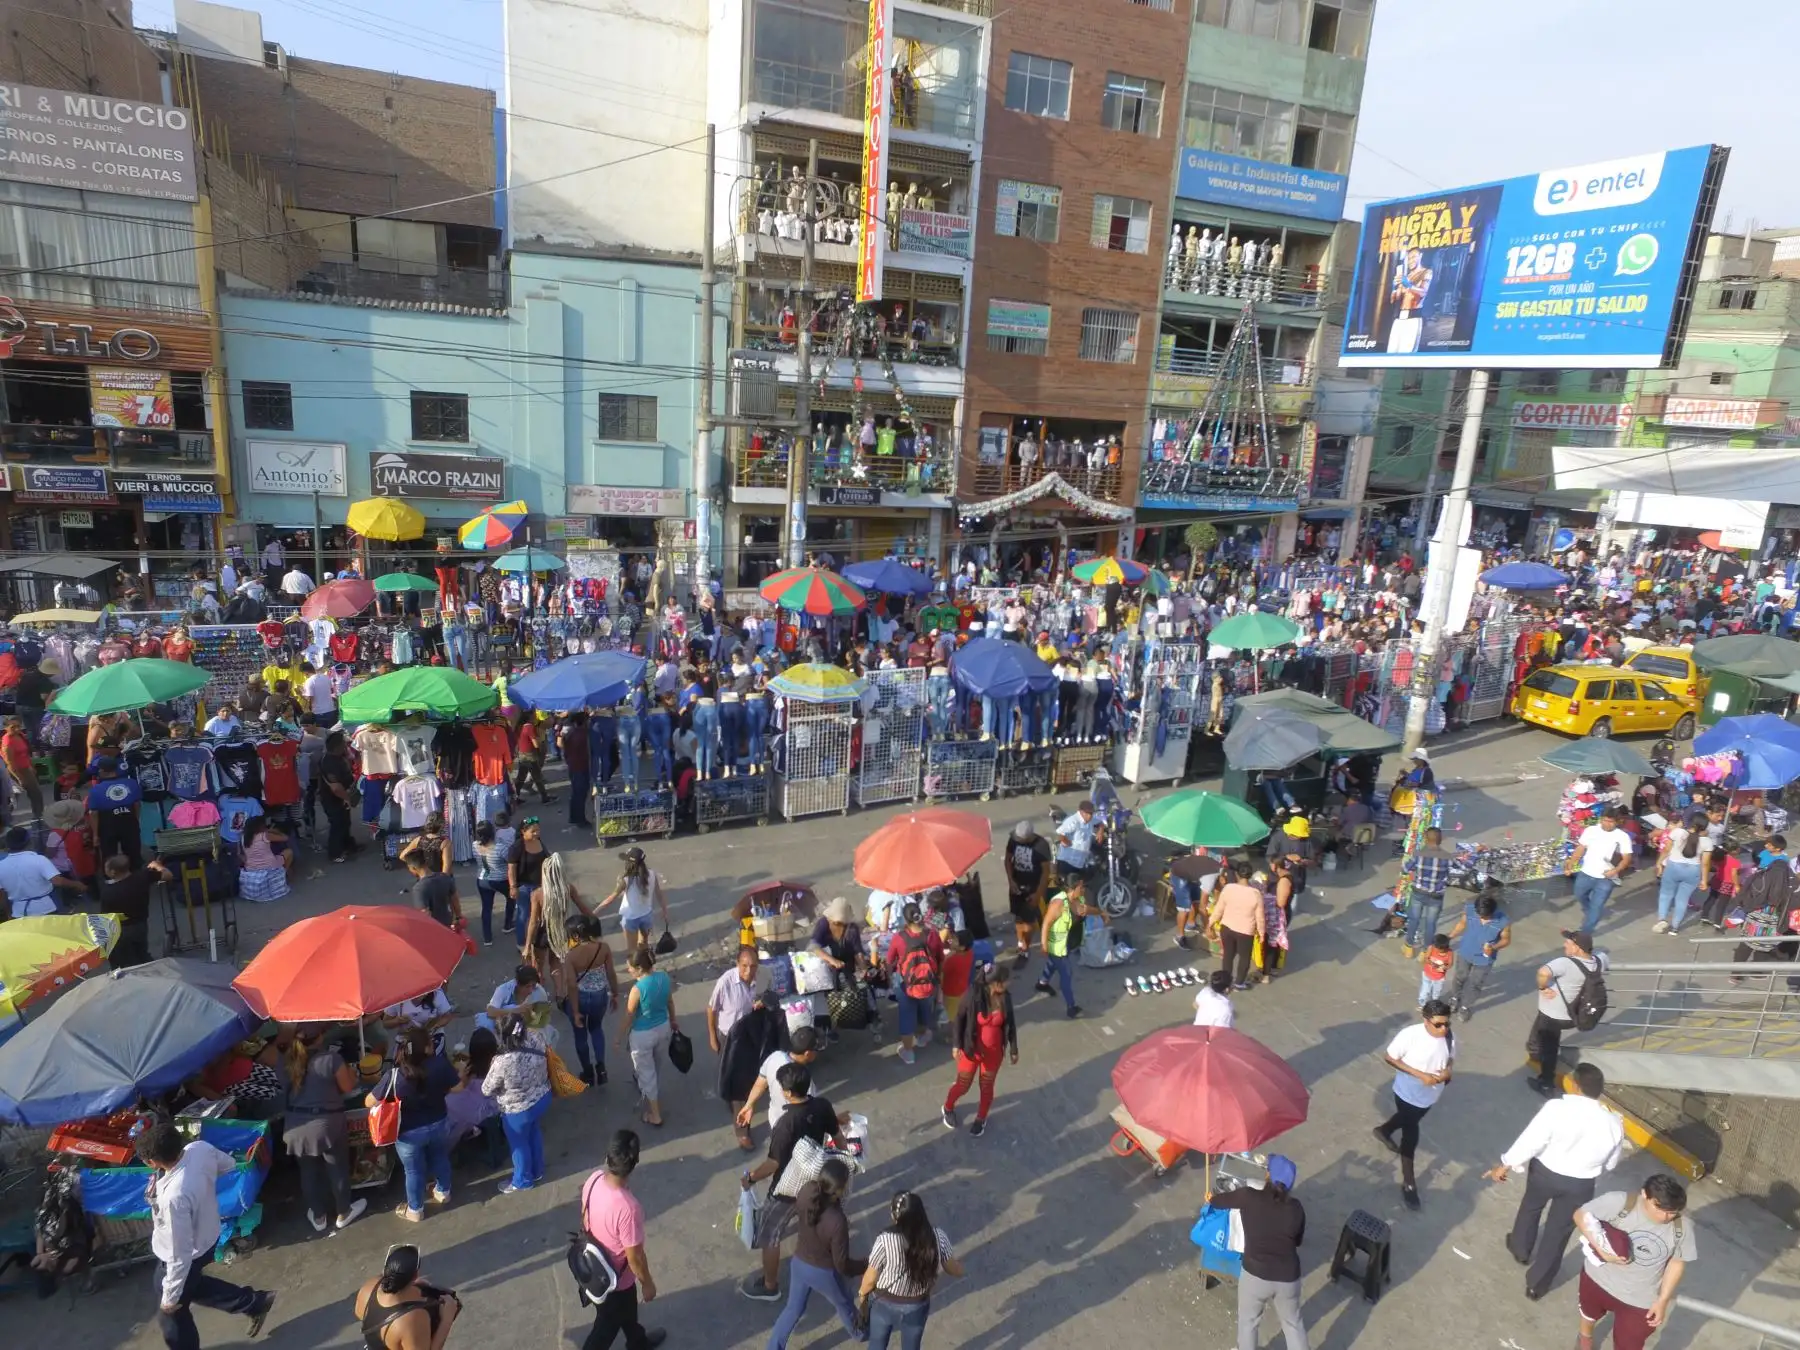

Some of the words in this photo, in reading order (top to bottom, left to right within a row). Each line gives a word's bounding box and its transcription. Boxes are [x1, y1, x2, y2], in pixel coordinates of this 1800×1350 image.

[37, 96, 52, 112] &
[64, 95, 187, 131] MUCCIO
[57, 118, 124, 134] COLLEZIONE
[73, 136, 184, 162] PANTALONES
[863, 0, 885, 297] AREQUIPA
[92, 161, 182, 183] CORBATAS
[1246, 166, 1299, 186] Industrial
[1300, 175, 1341, 192] Samuel
[1586, 168, 1646, 195] entel
[1208, 177, 1238, 191] VENTAS
[1239, 183, 1256, 194] POR
[1256, 185, 1284, 198] MAYOR
[1414, 202, 1448, 214] PREPAGO
[901, 209, 933, 225] ESTUDIO
[934, 213, 971, 230] CONTABLE
[1381, 209, 1453, 239] MIGRA
[1460, 204, 1478, 228] Y
[920, 225, 953, 239] TALIS
[1379, 227, 1474, 254] RECARGATE
[1531, 232, 1559, 243] SOLO
[1564, 228, 1587, 239] CON
[1591, 226, 1606, 236] TU
[1610, 222, 1640, 233] CHIP
[1506, 242, 1577, 278] 12GB
[1548, 285, 1563, 296] POR
[1565, 283, 1576, 294] UN
[1577, 280, 1596, 294] AÑO
[1495, 301, 1518, 320] SIN
[1519, 299, 1575, 318] GASTAR
[1576, 297, 1596, 316] TU
[1596, 294, 1649, 314] SALDO
[1348, 339, 1377, 349] entel.pe
[1521, 402, 1633, 427] CORTINAS
[1671, 400, 1758, 425] CORTINAS
[145, 473, 182, 481] TERNOS
[255, 466, 343, 484] Antonio's
[384, 468, 441, 485] MARCO
[446, 471, 501, 488] FRAZINI
[114, 481, 150, 492] VIERI
[152, 484, 160, 492] &
[162, 483, 214, 494] MUCCIO
[600, 489, 682, 500] HUMBOLDT
[598, 500, 659, 513] 1521
[1146, 493, 1190, 502] CENTRO
[1193, 494, 1254, 504] COMERCIAL
[62, 512, 91, 525] ENTRADA
